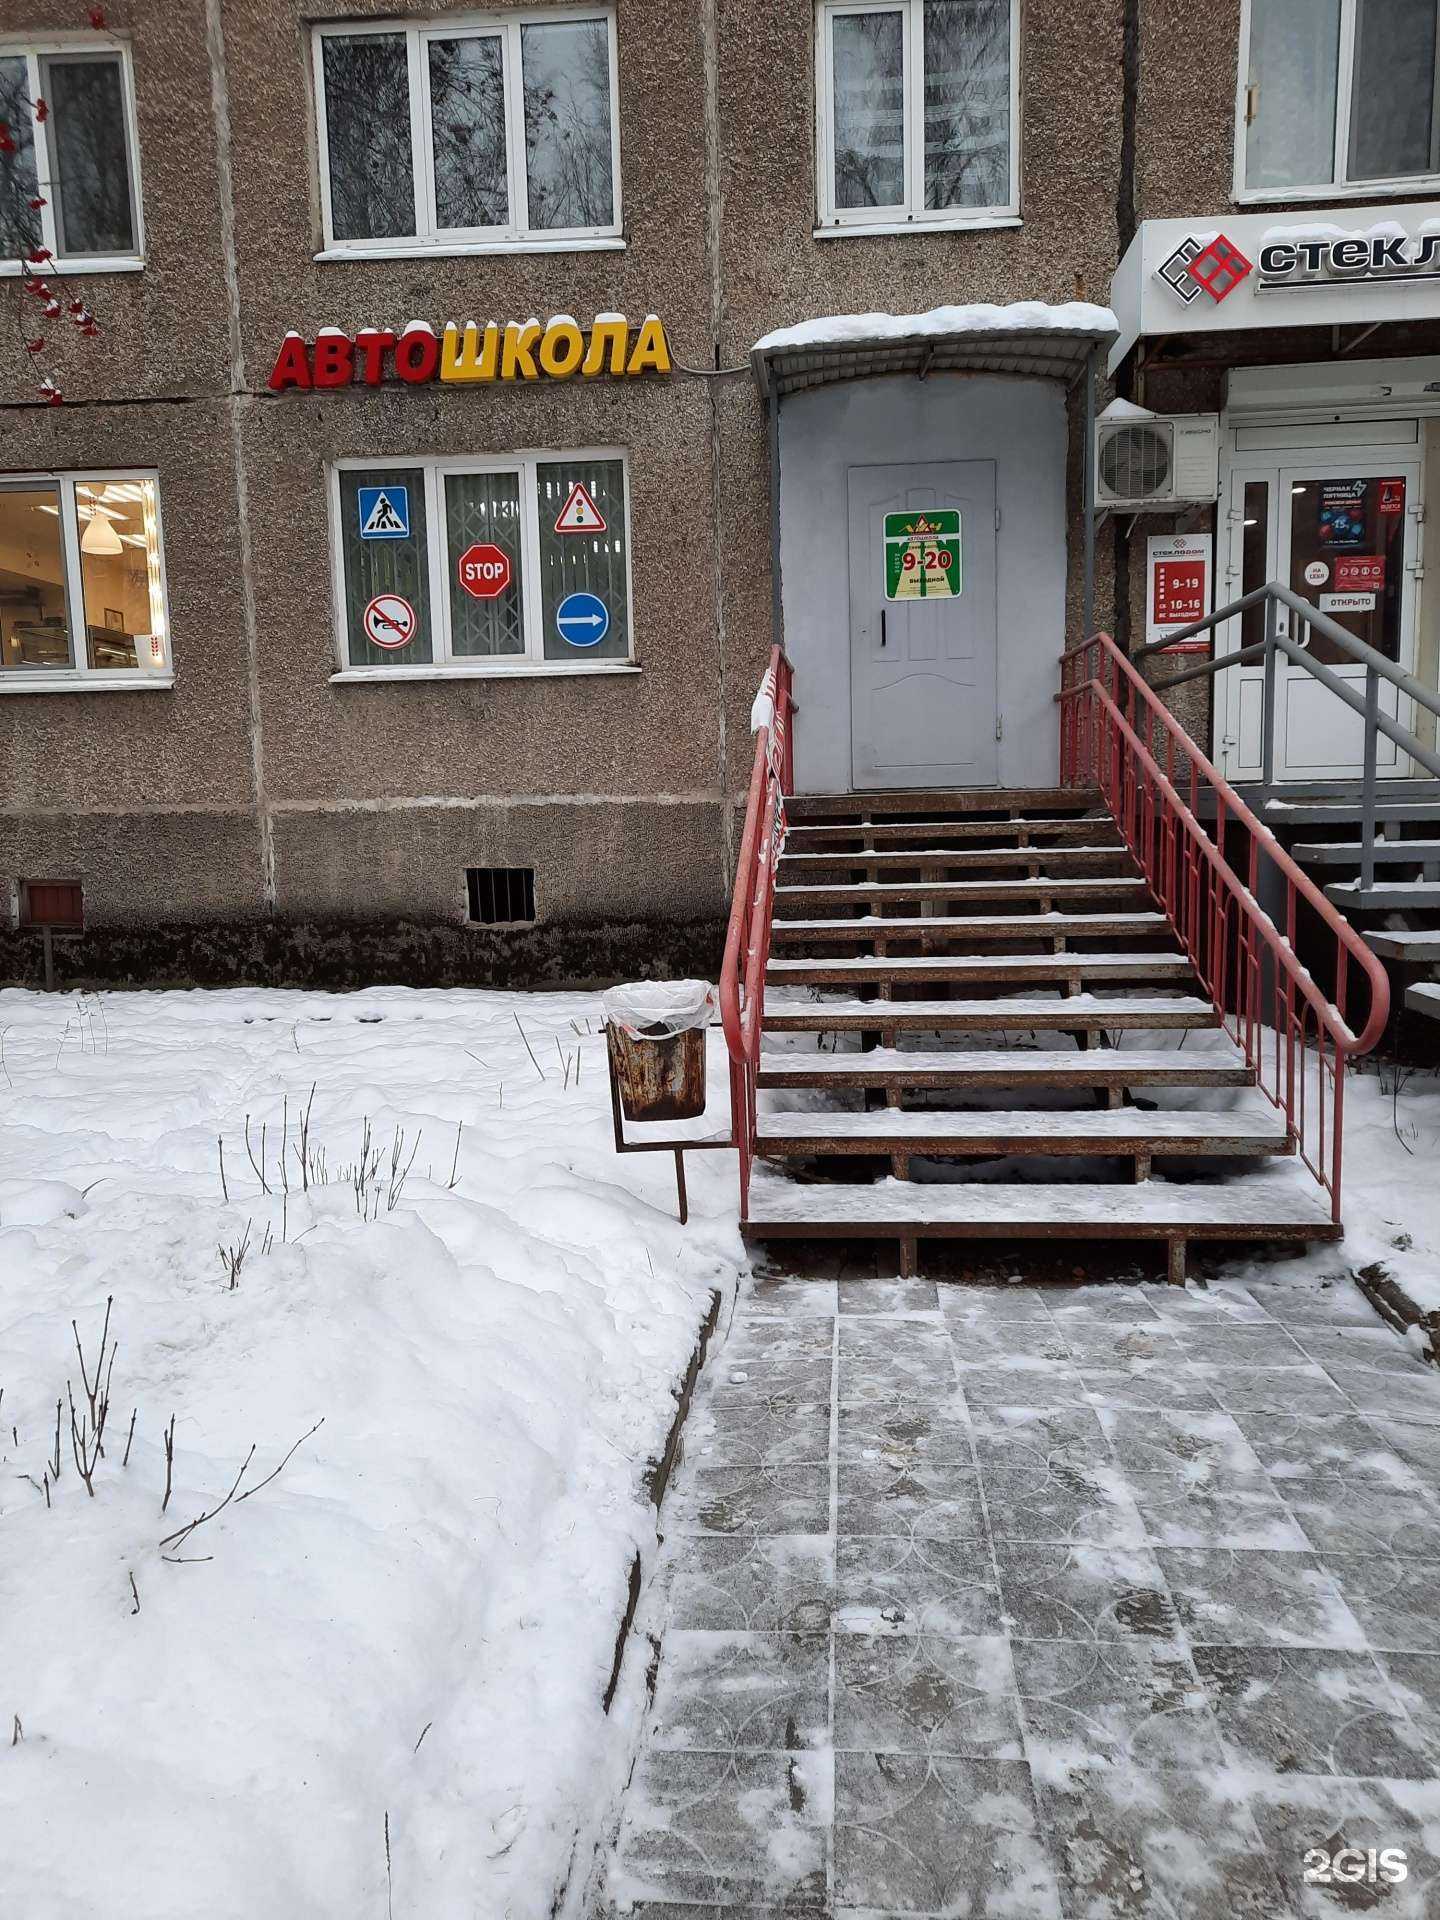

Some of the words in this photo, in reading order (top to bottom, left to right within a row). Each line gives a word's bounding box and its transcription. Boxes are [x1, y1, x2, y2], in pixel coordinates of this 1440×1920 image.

[268, 316, 672, 390] АВТОШКОЛА
[902, 550, 952, 571] 9-20
[465, 562, 504, 580] STOP
[1172, 578, 1199, 589] 9-19
[1170, 599, 1200, 610] 10-16
[1330, 598, 1371, 607] ОТКРЫТО
